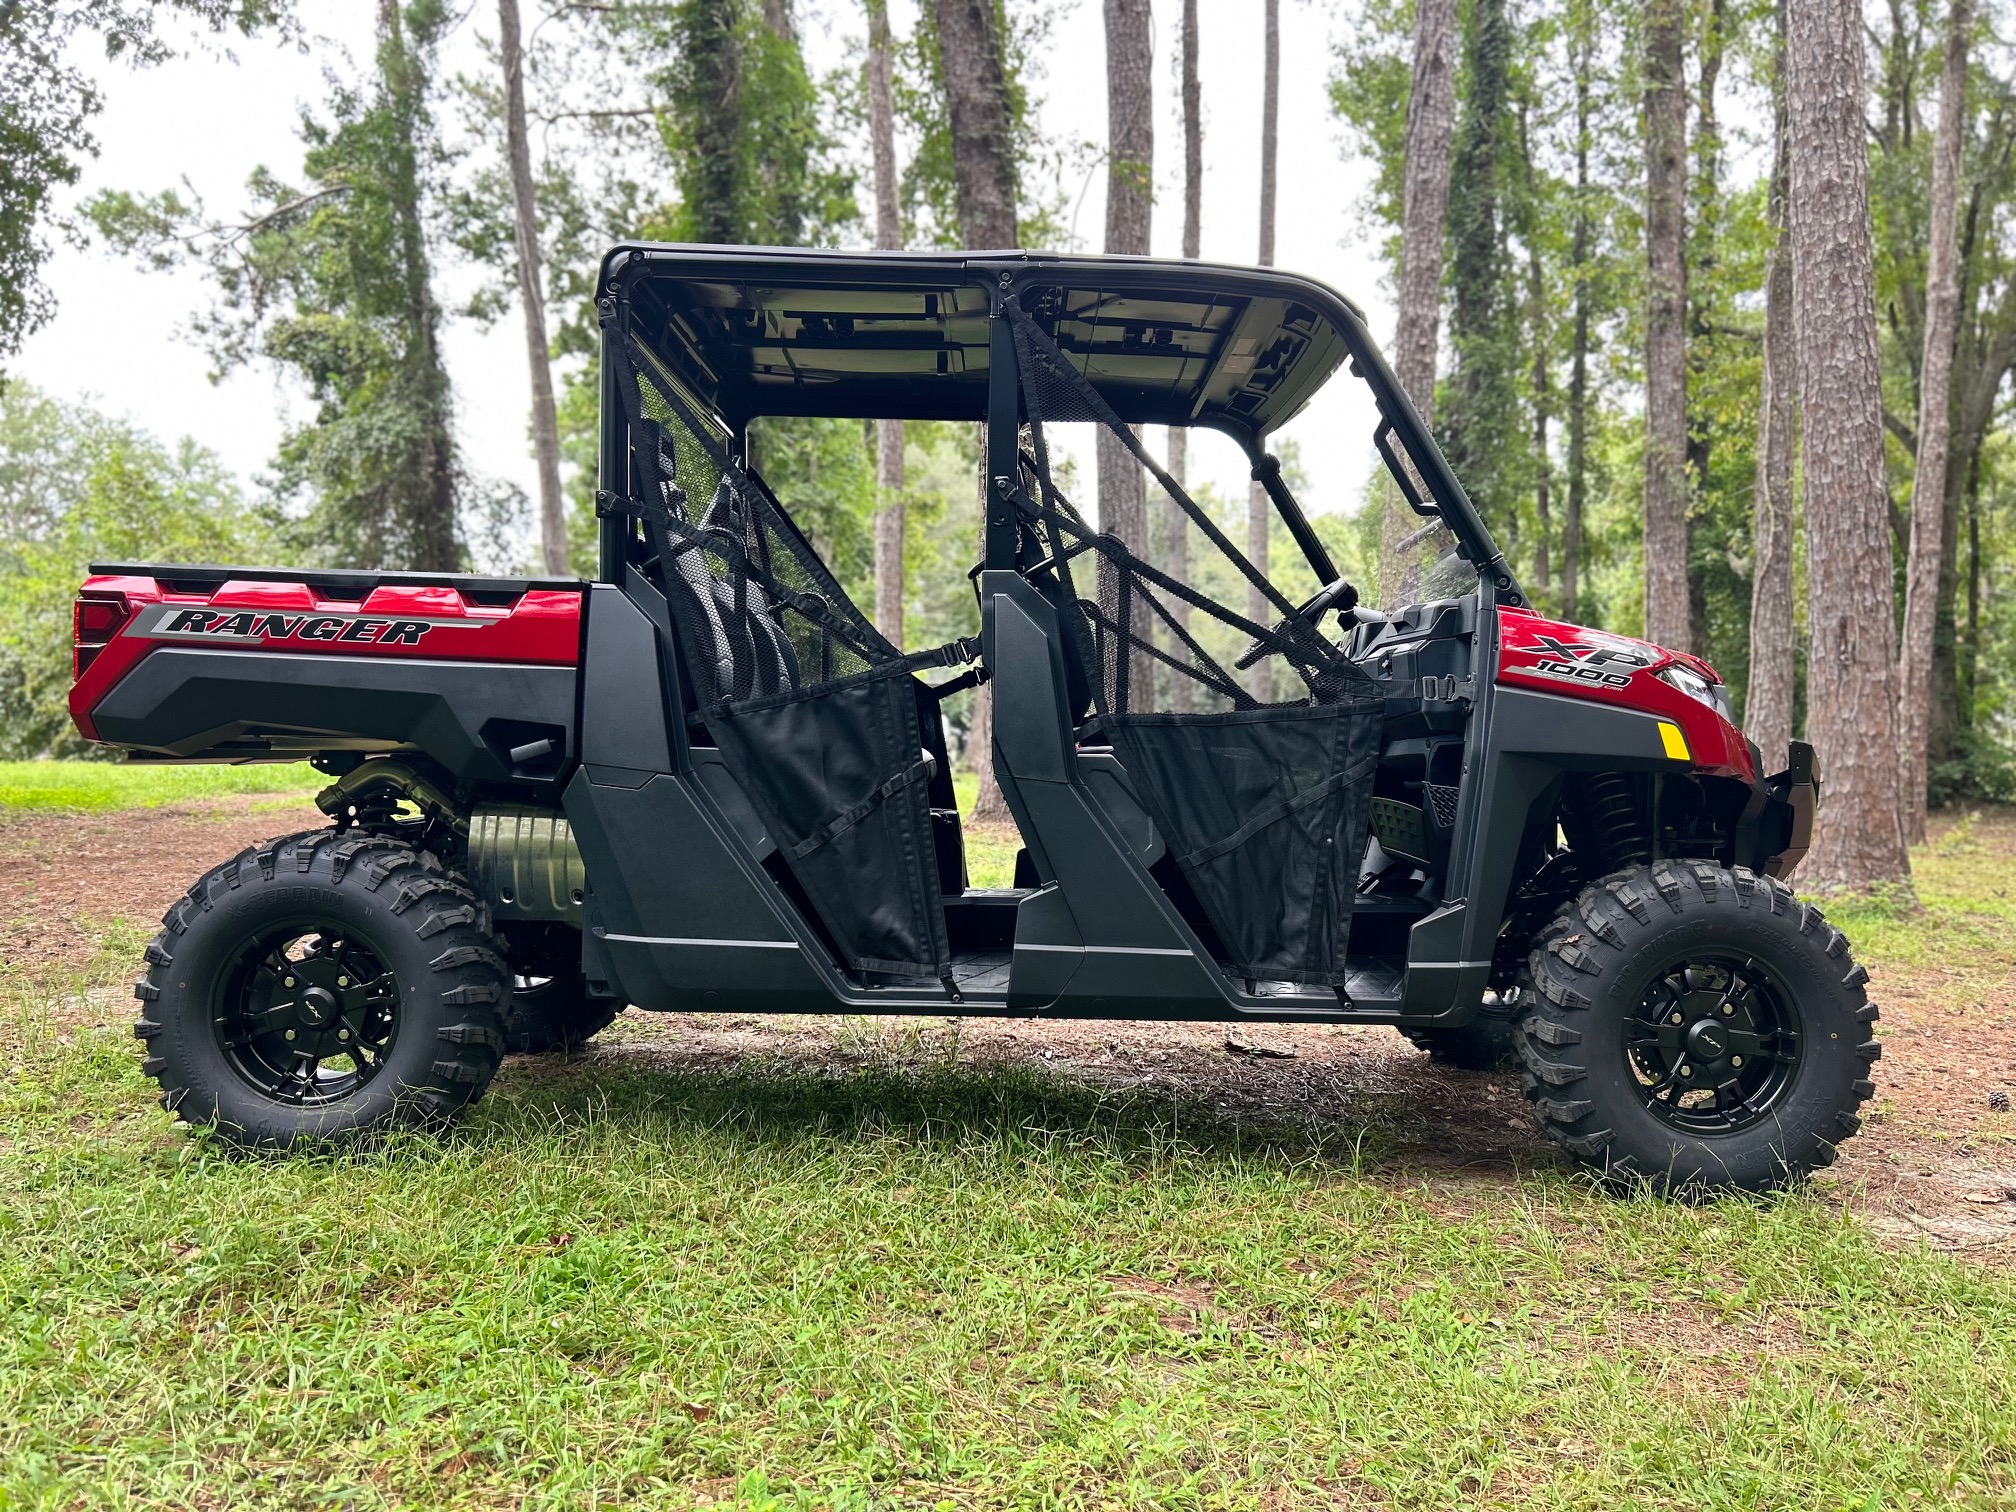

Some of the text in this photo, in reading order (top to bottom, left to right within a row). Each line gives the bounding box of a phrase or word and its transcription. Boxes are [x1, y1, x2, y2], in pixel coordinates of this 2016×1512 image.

[165, 608, 432, 645] RANGER
[1517, 633, 1653, 667] XP
[1536, 659, 1633, 688] 1000
[1603, 684, 1624, 692] CAM
